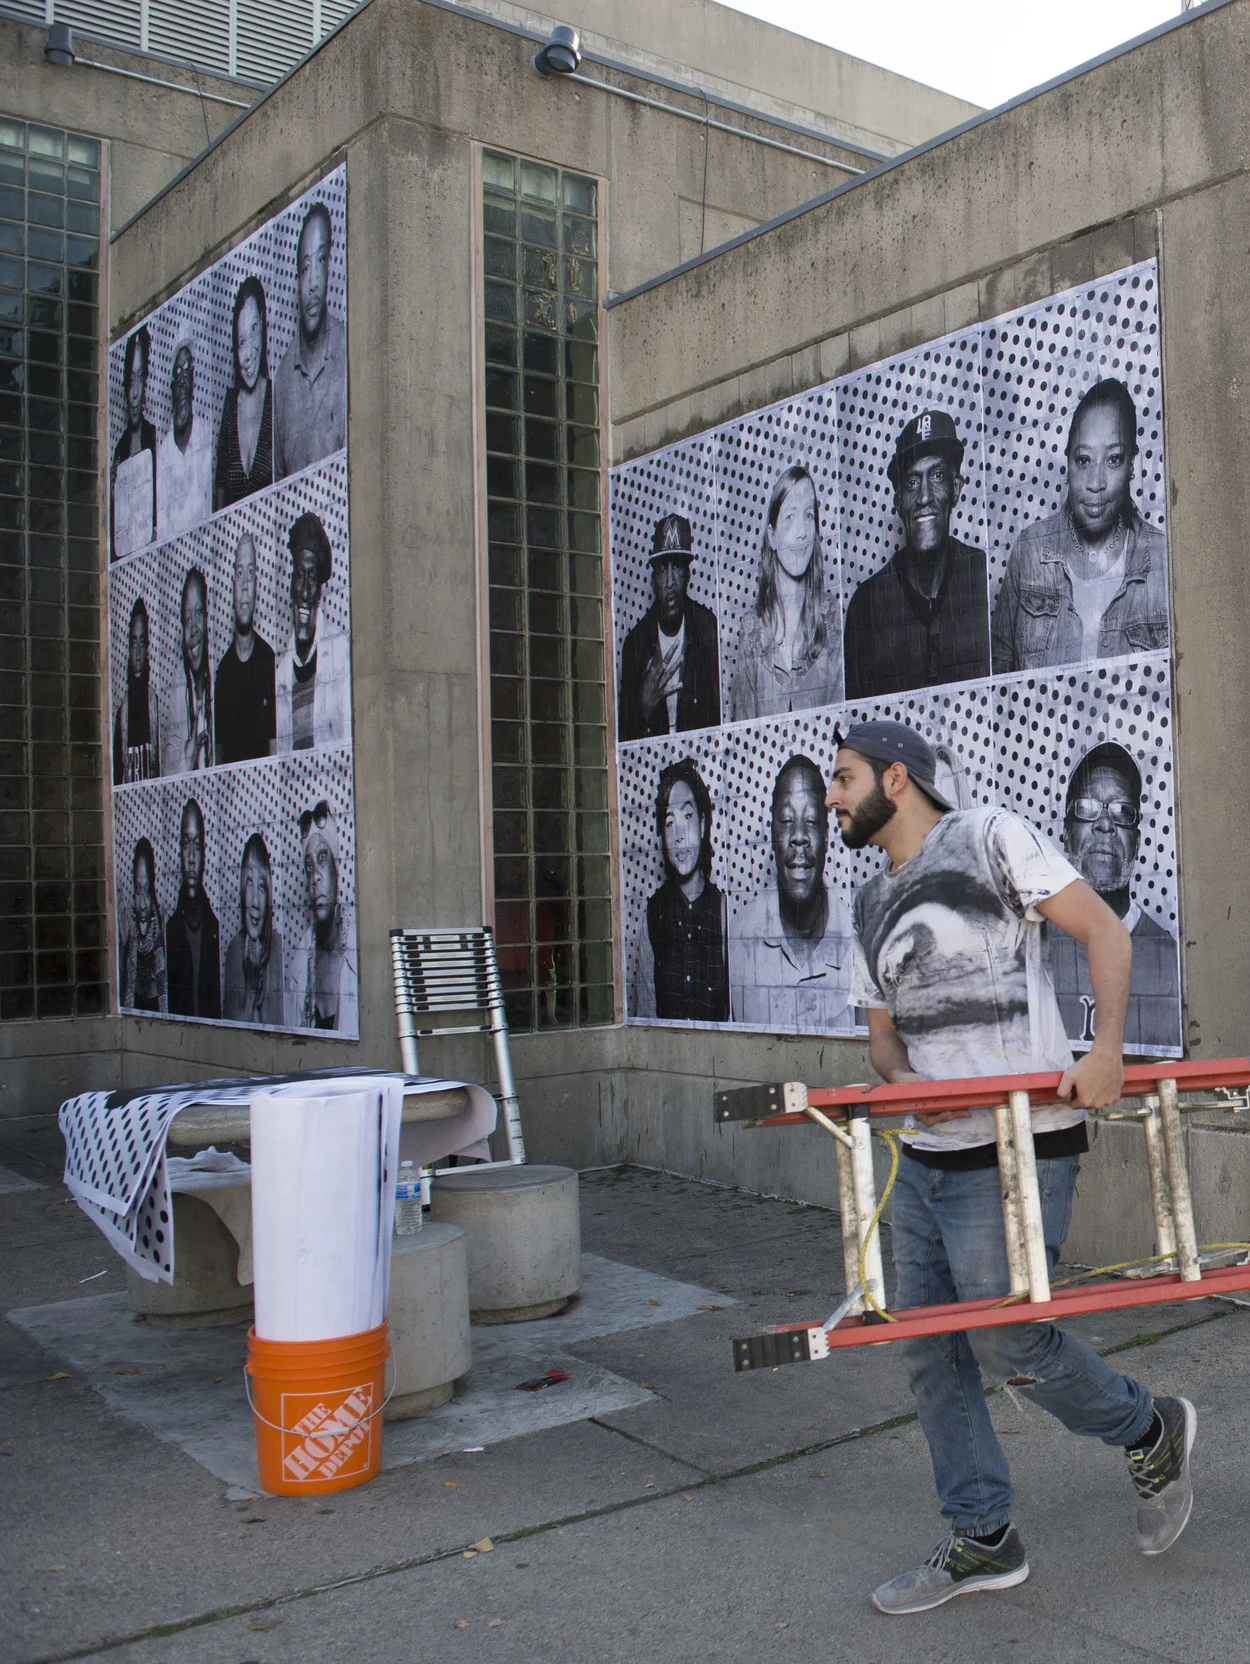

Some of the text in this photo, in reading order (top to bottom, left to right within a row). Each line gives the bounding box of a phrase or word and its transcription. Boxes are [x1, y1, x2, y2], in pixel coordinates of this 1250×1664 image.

[283, 1386, 373, 1481] HOME
[291, 1402, 331, 1437] THE
[317, 1417, 370, 1478] DEPOT
